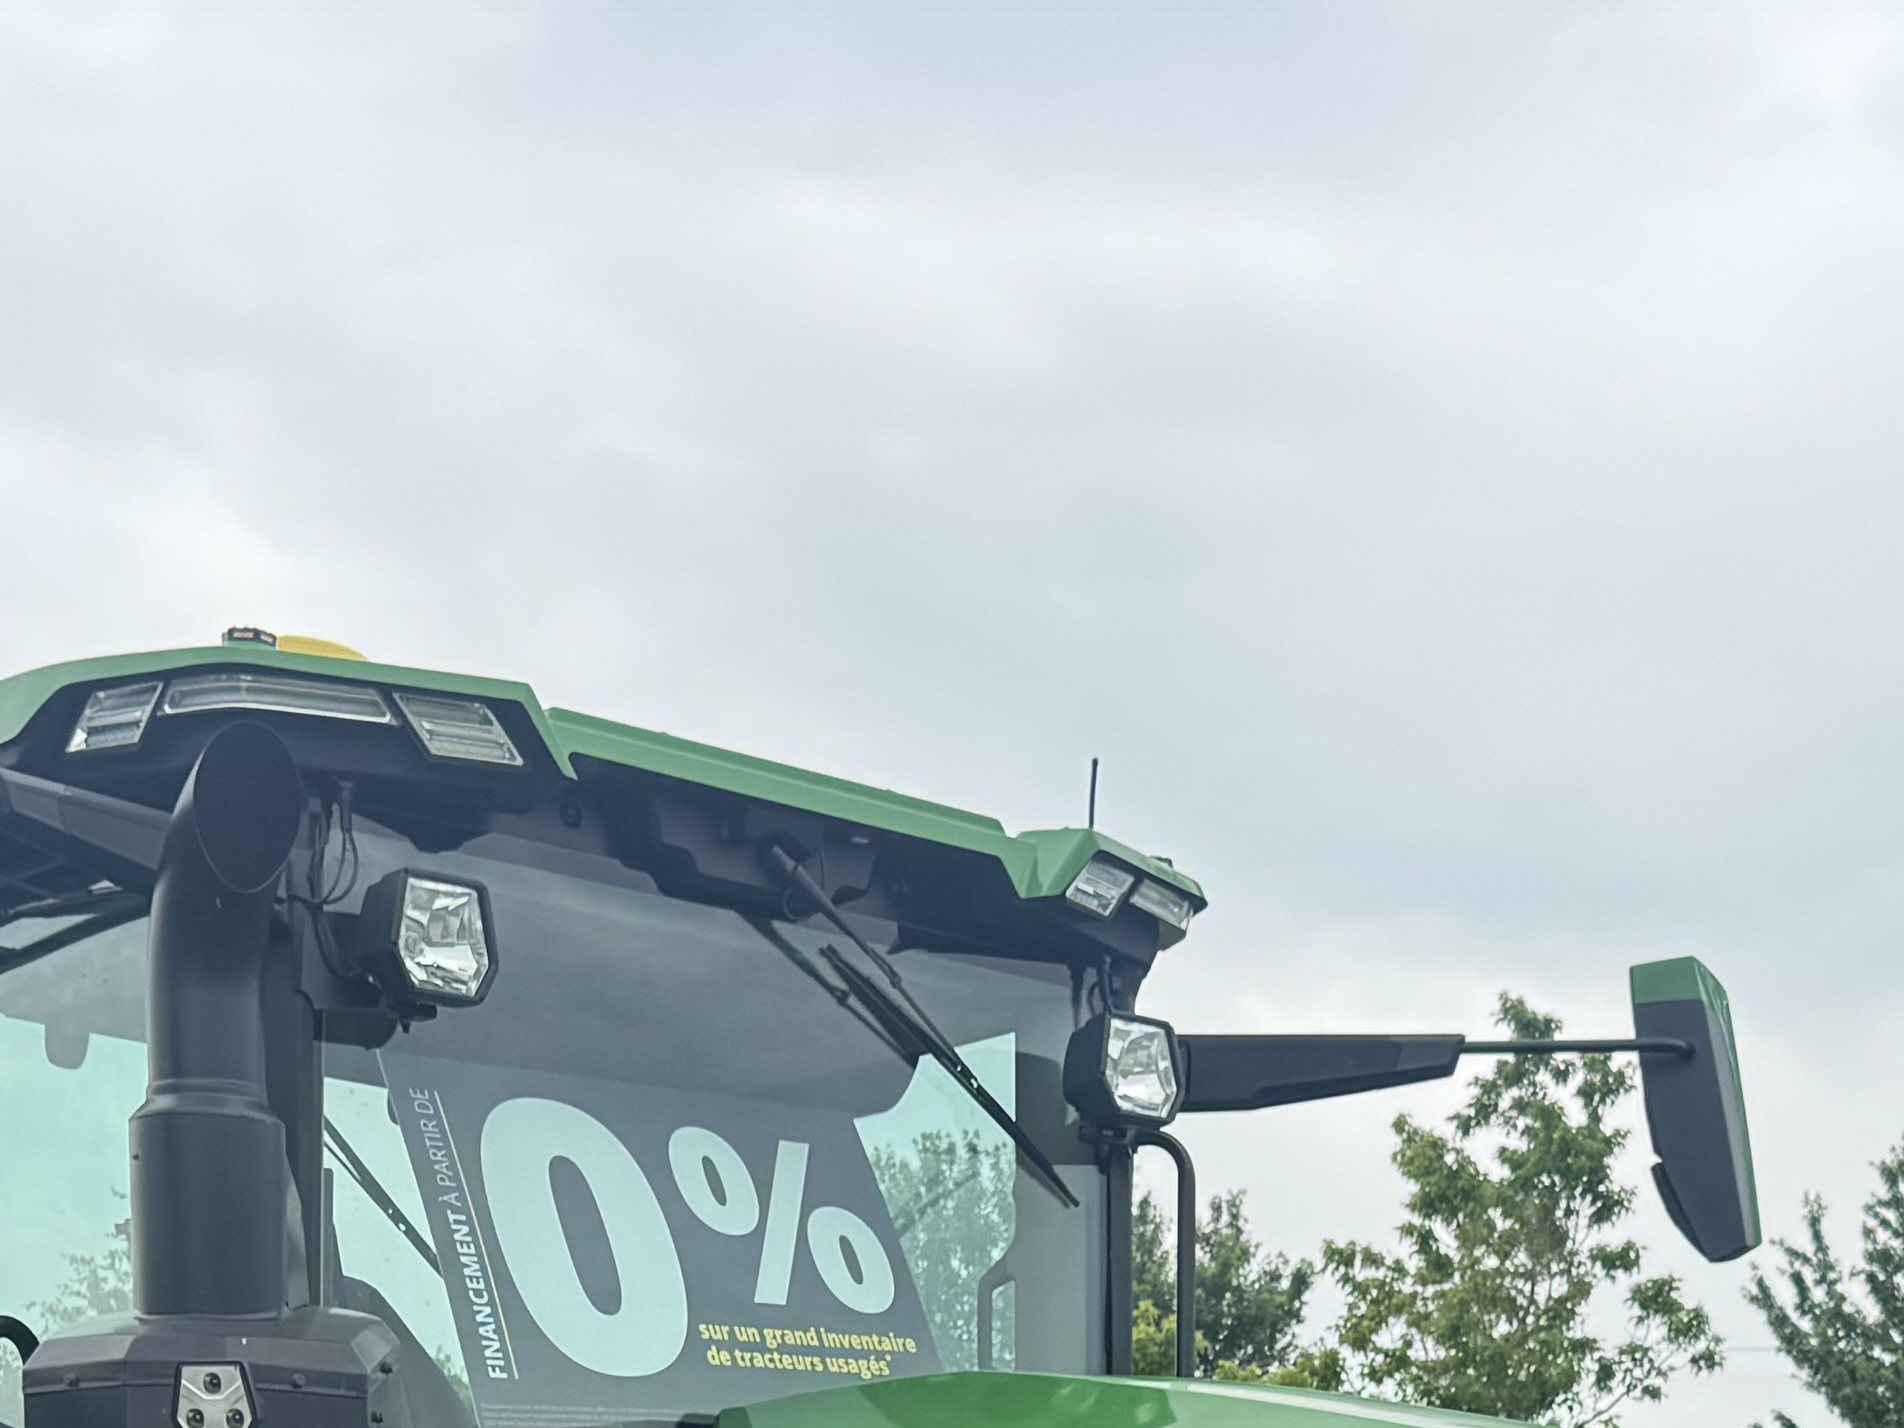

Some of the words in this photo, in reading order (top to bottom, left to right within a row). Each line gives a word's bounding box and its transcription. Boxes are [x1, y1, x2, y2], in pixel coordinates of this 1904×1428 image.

[409, 1087, 434, 1114] DE
[420, 1119, 456, 1187] PARTIR
[438, 1192, 462, 1207] À
[446, 1209, 508, 1379] FINANCEMENT
[698, 1323, 730, 1341] sur
[734, 1325, 761, 1342] un
[763, 1327, 819, 1349] grand
[820, 1327, 917, 1353] inventaire
[706, 1345, 732, 1366] de
[734, 1348, 824, 1372] tracteurs
